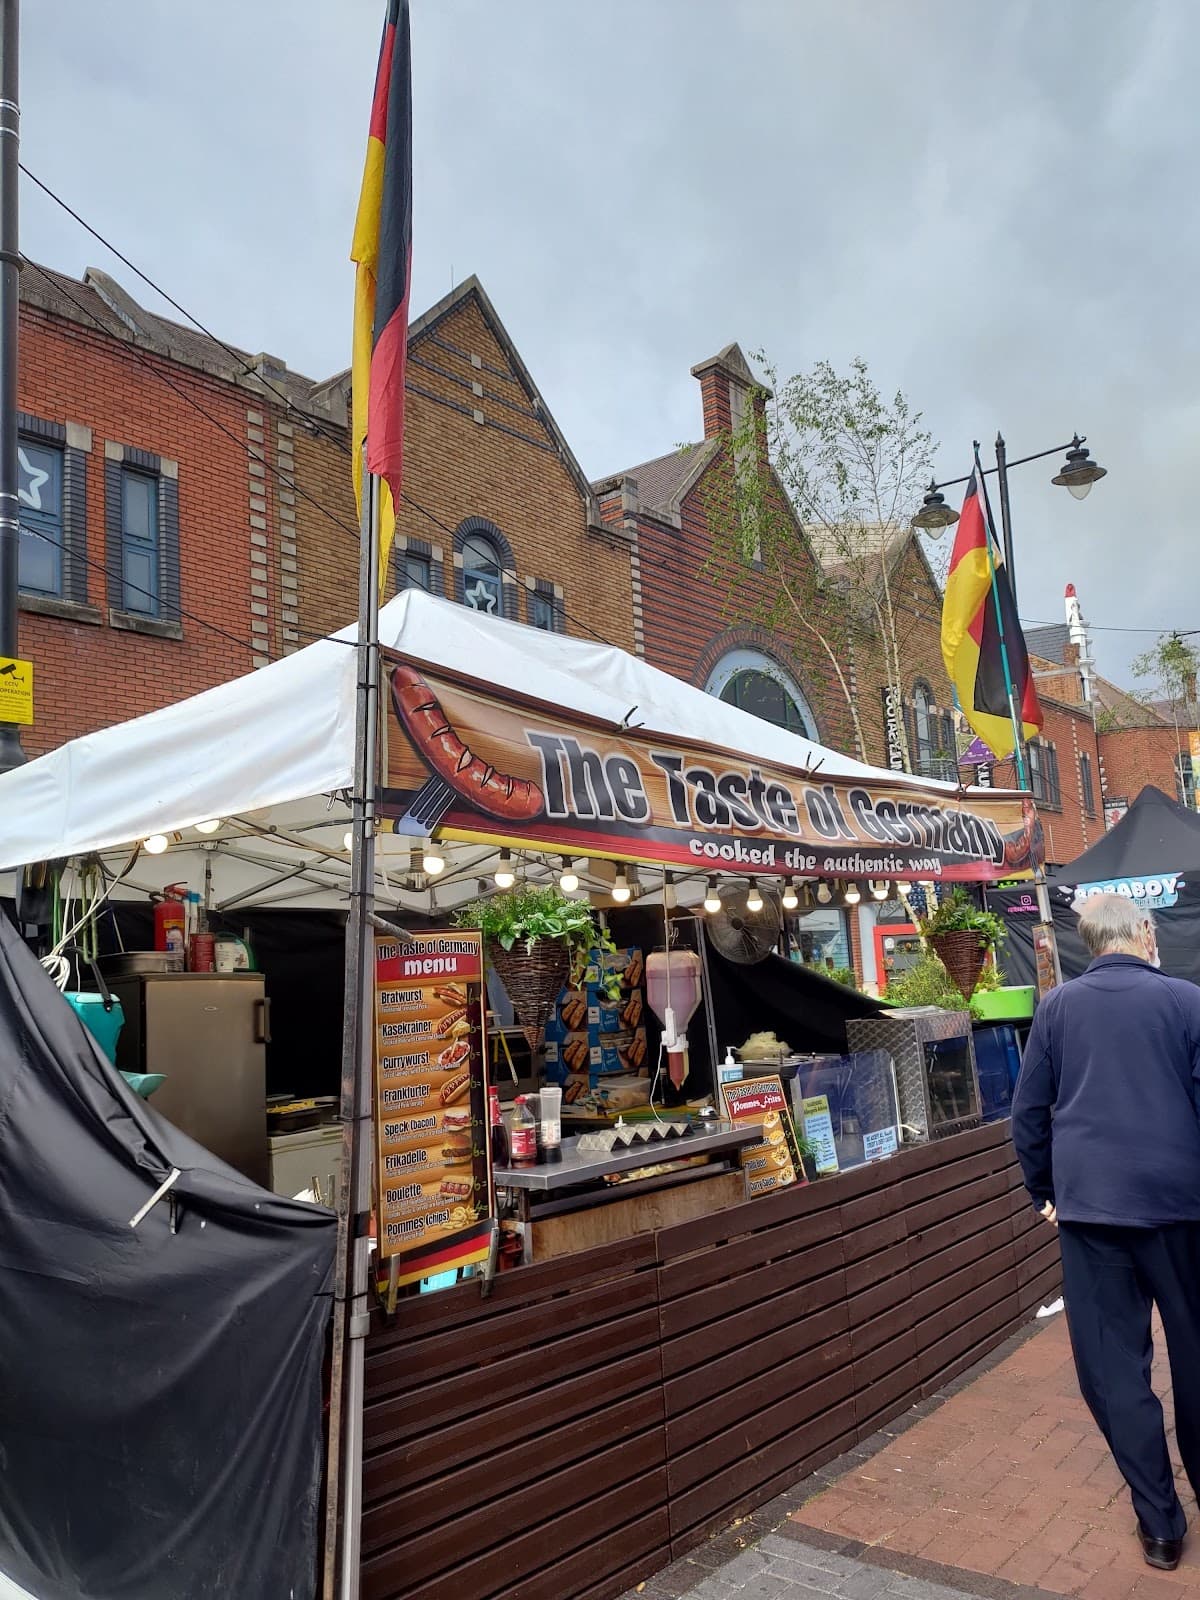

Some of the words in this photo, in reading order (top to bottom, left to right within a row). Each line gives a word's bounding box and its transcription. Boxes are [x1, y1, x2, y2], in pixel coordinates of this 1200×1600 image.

[525, 729, 651, 823] The
[650, 750, 803, 838] Taste
[848, 797, 1004, 865] Germany
[688, 837, 777, 868] cooked
[785, 847, 817, 872] the
[823, 855, 905, 874] authentic
[908, 856, 942, 877] way
[378, 945, 397, 960] The
[399, 941, 425, 957] Taste
[438, 939, 479, 956] Germany
[404, 957, 457, 976] menu
[381, 988, 423, 1005] Bratwurst
[382, 1020, 432, 1037] Kasekrainer
[383, 1052, 430, 1070] Currywurst
[383, 1084, 431, 1103] Frankfurter
[733, 1099, 761, 1114] Pommes
[384, 1123, 409, 1136] Speck
[410, 1115, 436, 1132] (bacon)
[385, 1149, 428, 1170] Frikadelle
[762, 1177, 776, 1188] Sauce
[386, 1183, 422, 1203] Boulette
[387, 1217, 424, 1238] Pommes
[425, 1208, 450, 1226] (chips)
